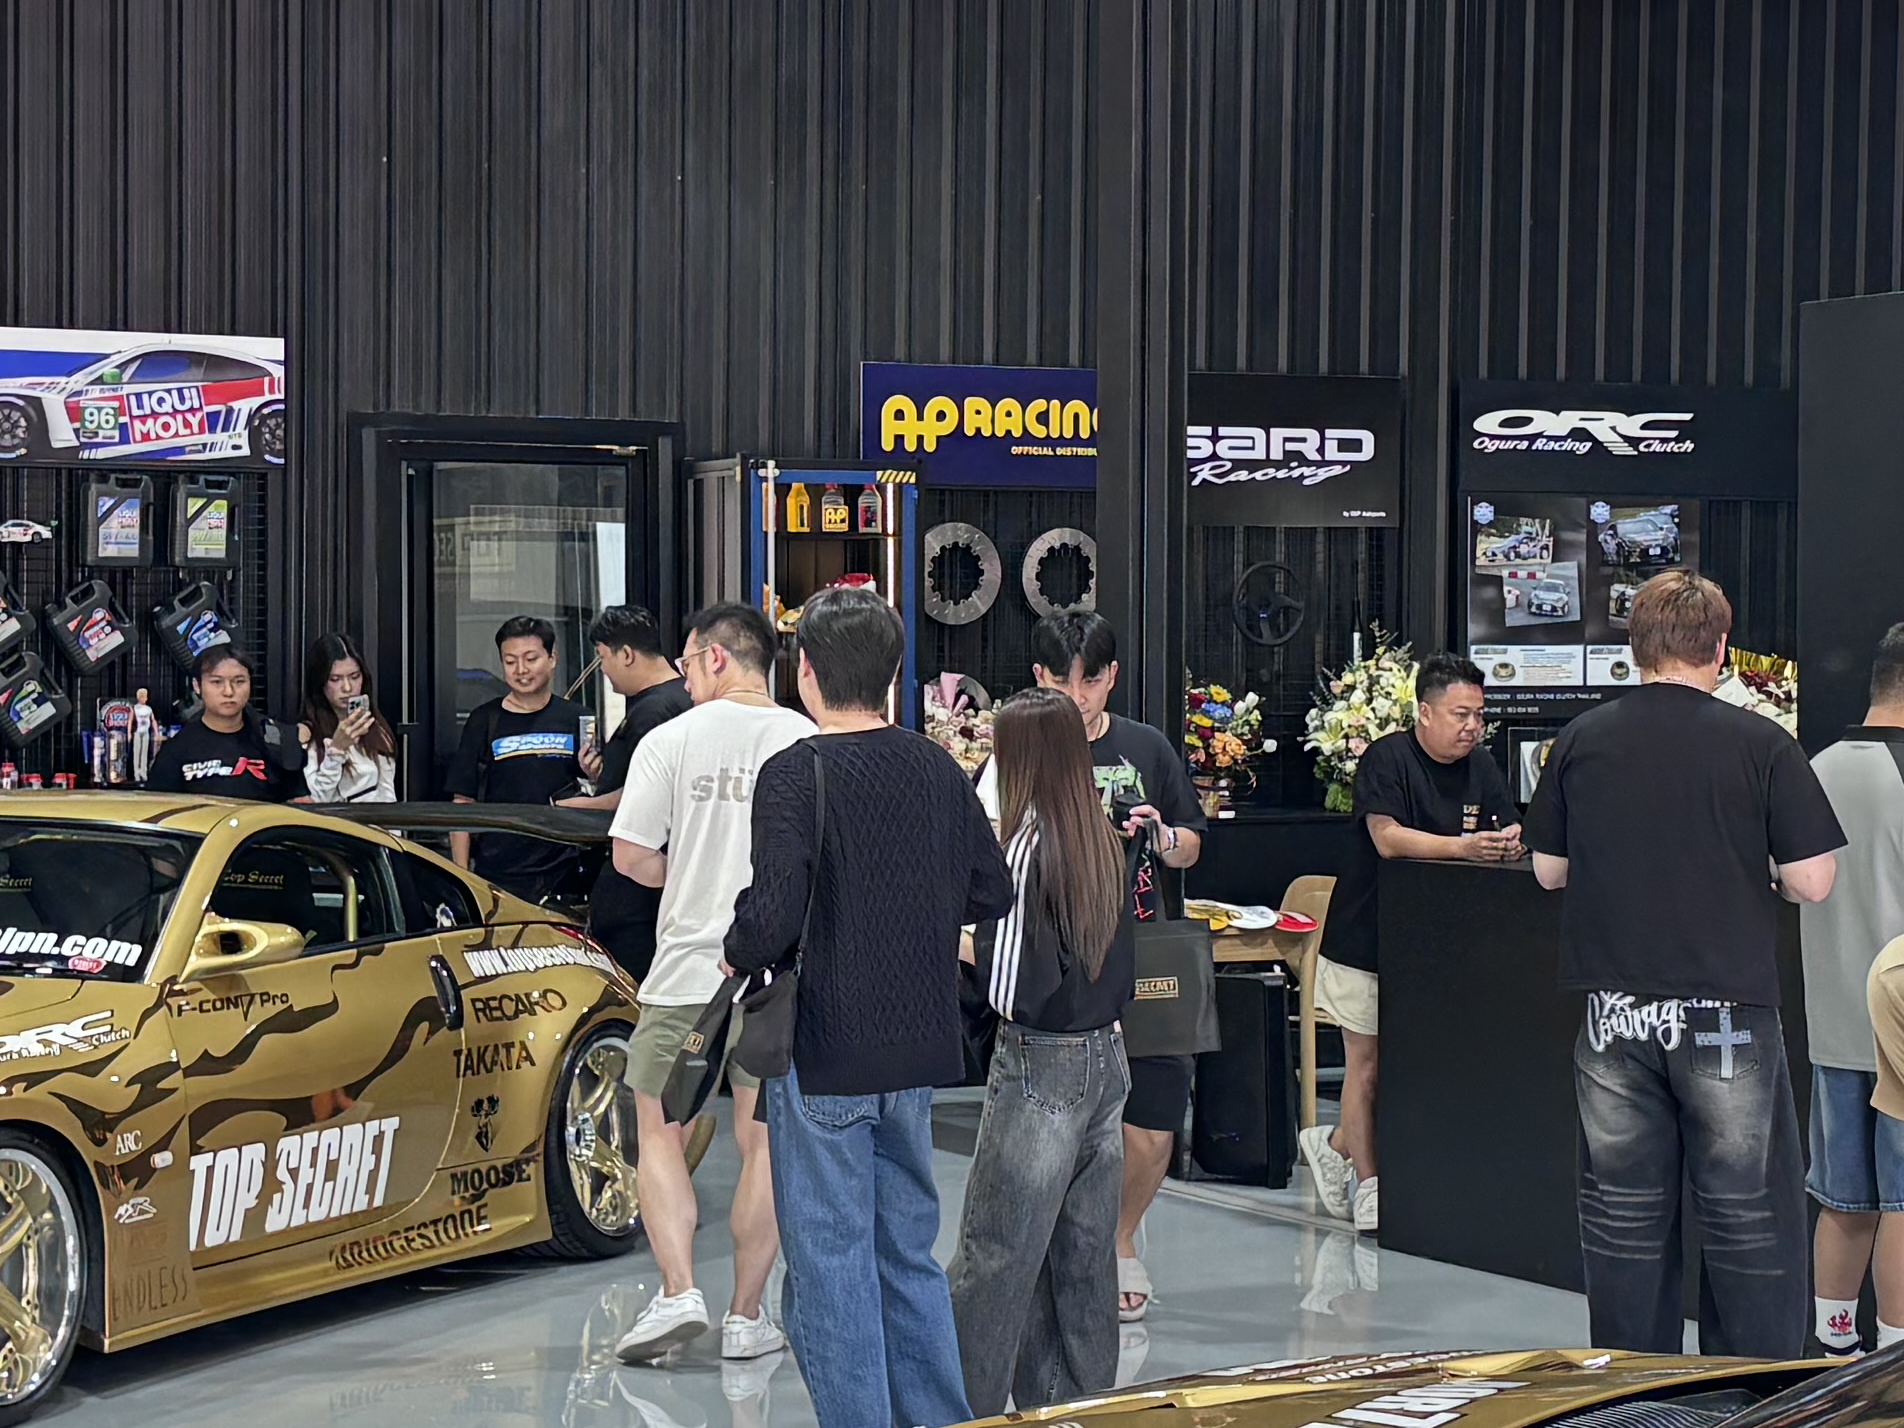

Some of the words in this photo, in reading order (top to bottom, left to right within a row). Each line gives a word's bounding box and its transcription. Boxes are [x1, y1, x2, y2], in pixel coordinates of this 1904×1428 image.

[128, 385, 201, 416] LIQUI
[83, 407, 115, 430] 96
[132, 411, 206, 443] MOLY
[881, 394, 960, 453] AP
[963, 396, 1098, 440] RACIN
[1473, 409, 1694, 456] ORC
[1011, 445, 1053, 457] OFFICIAL
[1473, 436, 1529, 454] Ogura
[1531, 437, 1593, 456] Racing
[1638, 437, 1694, 453] Clutch
[1191, 461, 1351, 487] Racing
[230, 756, 268, 781] R
[259, 989, 290, 1008] Pro
[470, 987, 568, 1024] RECARO
[91, 1027, 131, 1046] Clutch
[452, 1039, 536, 1079] TAKATA
[114, 1129, 143, 1156] ARC
[189, 1141, 267, 1252] TOP
[264, 1115, 400, 1234] SECRET
[450, 1161, 532, 1196] MOOSE
[329, 1202, 494, 1272] BRIDGESTONE
